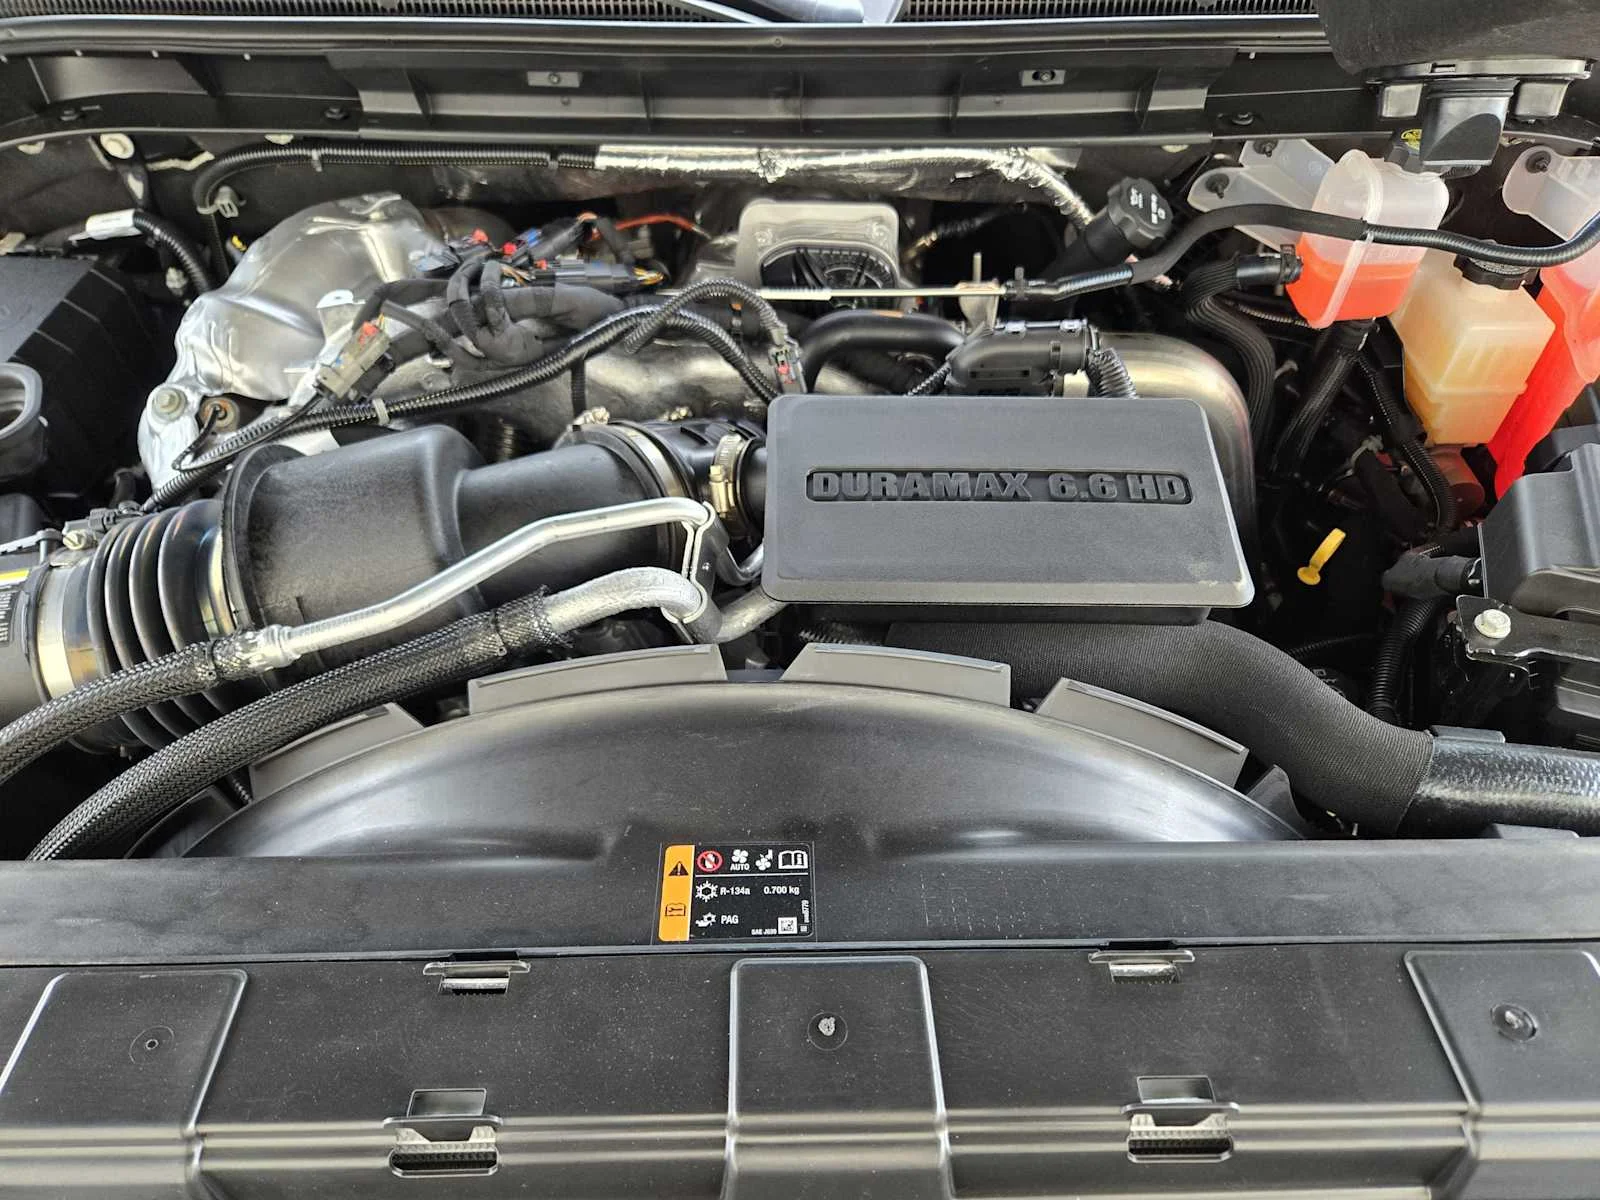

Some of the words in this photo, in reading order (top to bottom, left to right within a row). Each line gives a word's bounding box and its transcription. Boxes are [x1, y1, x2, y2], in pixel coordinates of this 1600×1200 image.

[812, 472, 1032, 499] DURAMAX
[1048, 473, 1117, 499] 6.6
[1126, 474, 1188, 500] HD
[730, 863, 750, 871] AUTO
[720, 887, 750, 895] R-134a
[763, 886, 788, 895] 0.700
[789, 886, 800, 896] kg
[720, 915, 739, 925] PAG
